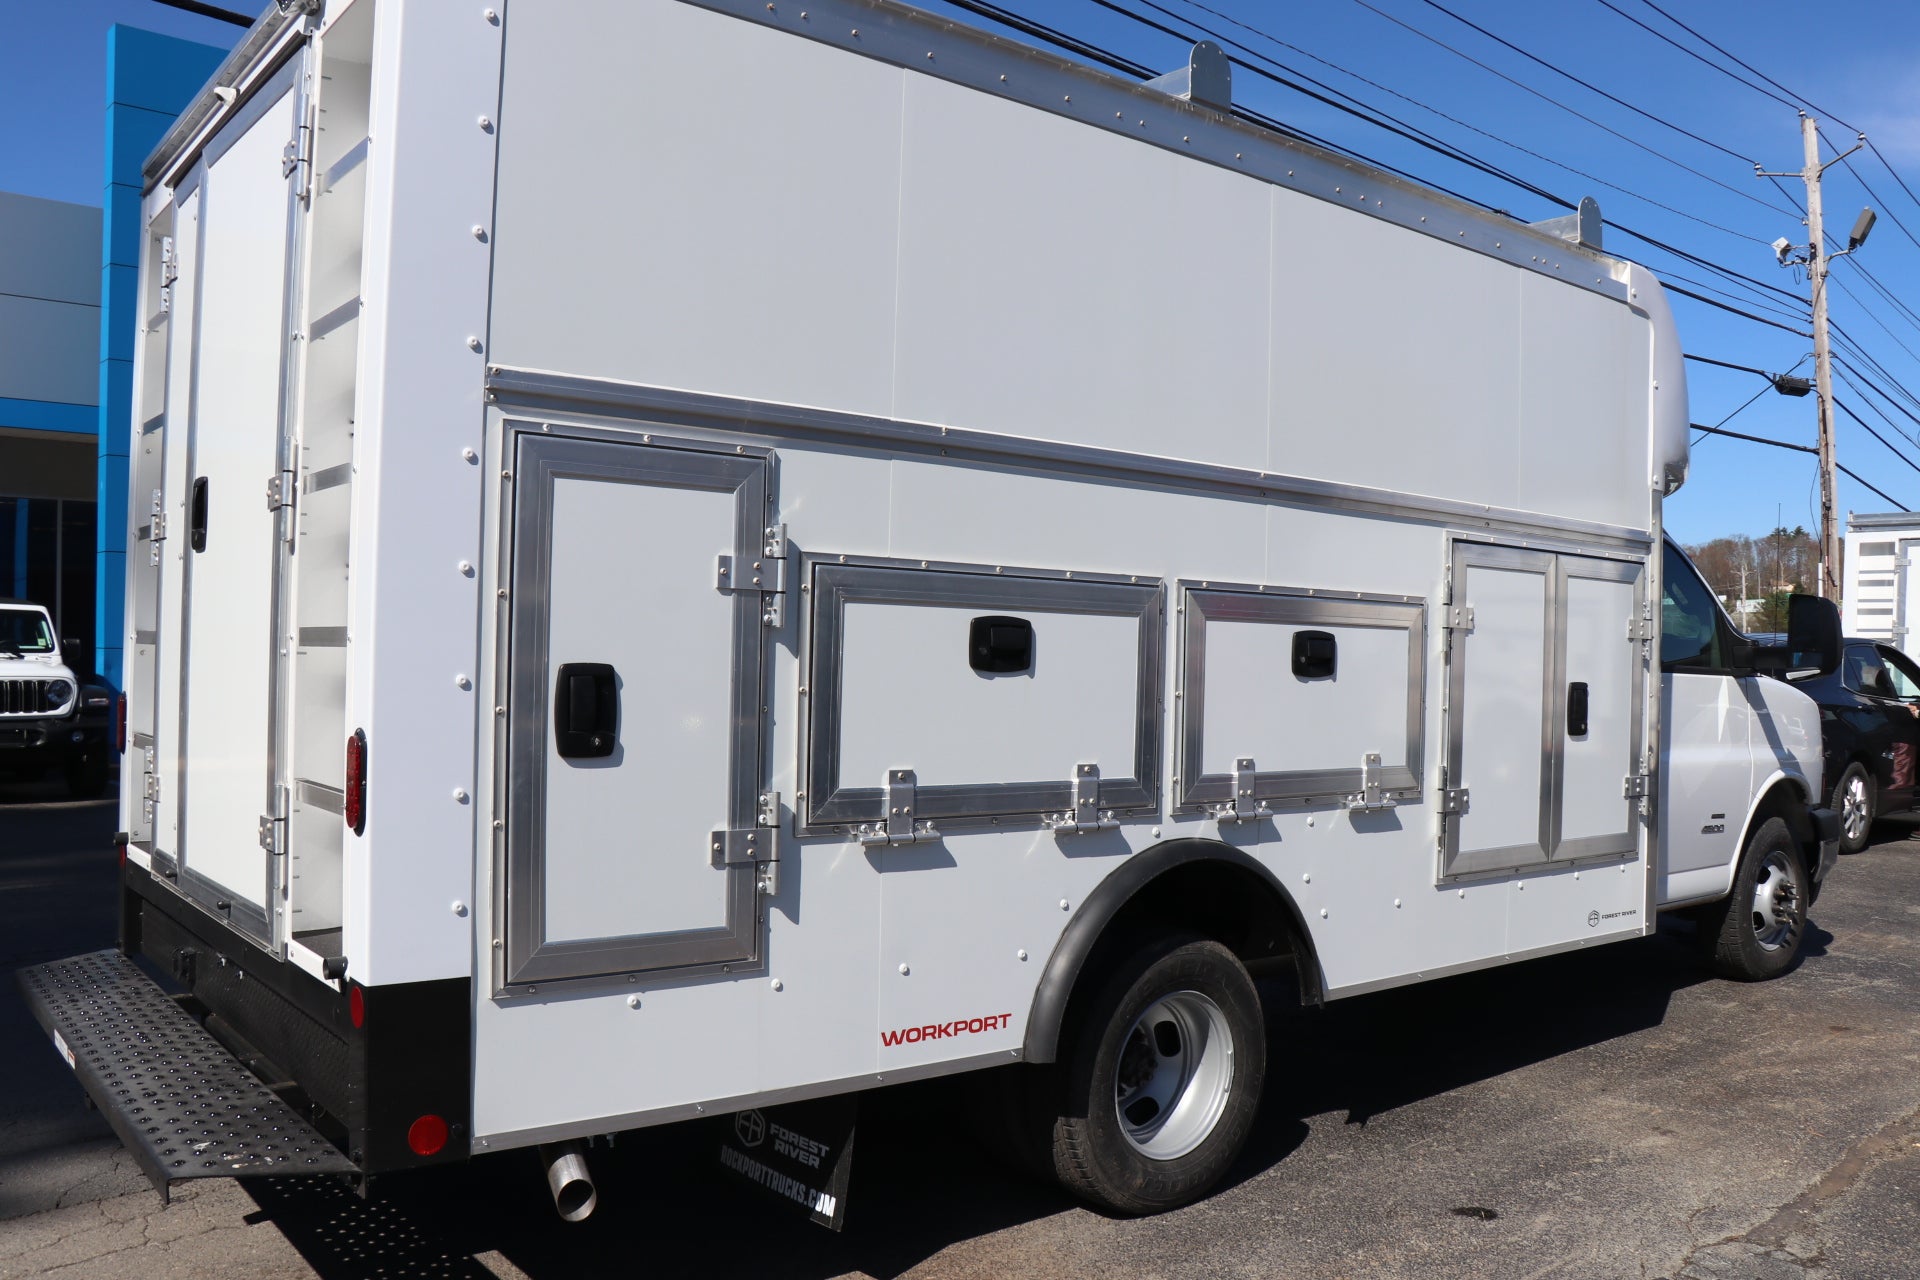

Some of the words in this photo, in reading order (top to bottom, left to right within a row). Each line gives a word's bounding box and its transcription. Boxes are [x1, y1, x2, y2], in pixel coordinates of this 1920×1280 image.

[881, 1013, 1012, 1047] WORKPORT
[770, 1122, 830, 1158] FOREST
[774, 1139, 821, 1169] RIVER
[720, 1144, 837, 1218] ROCKPORTTRUCKS.COM
